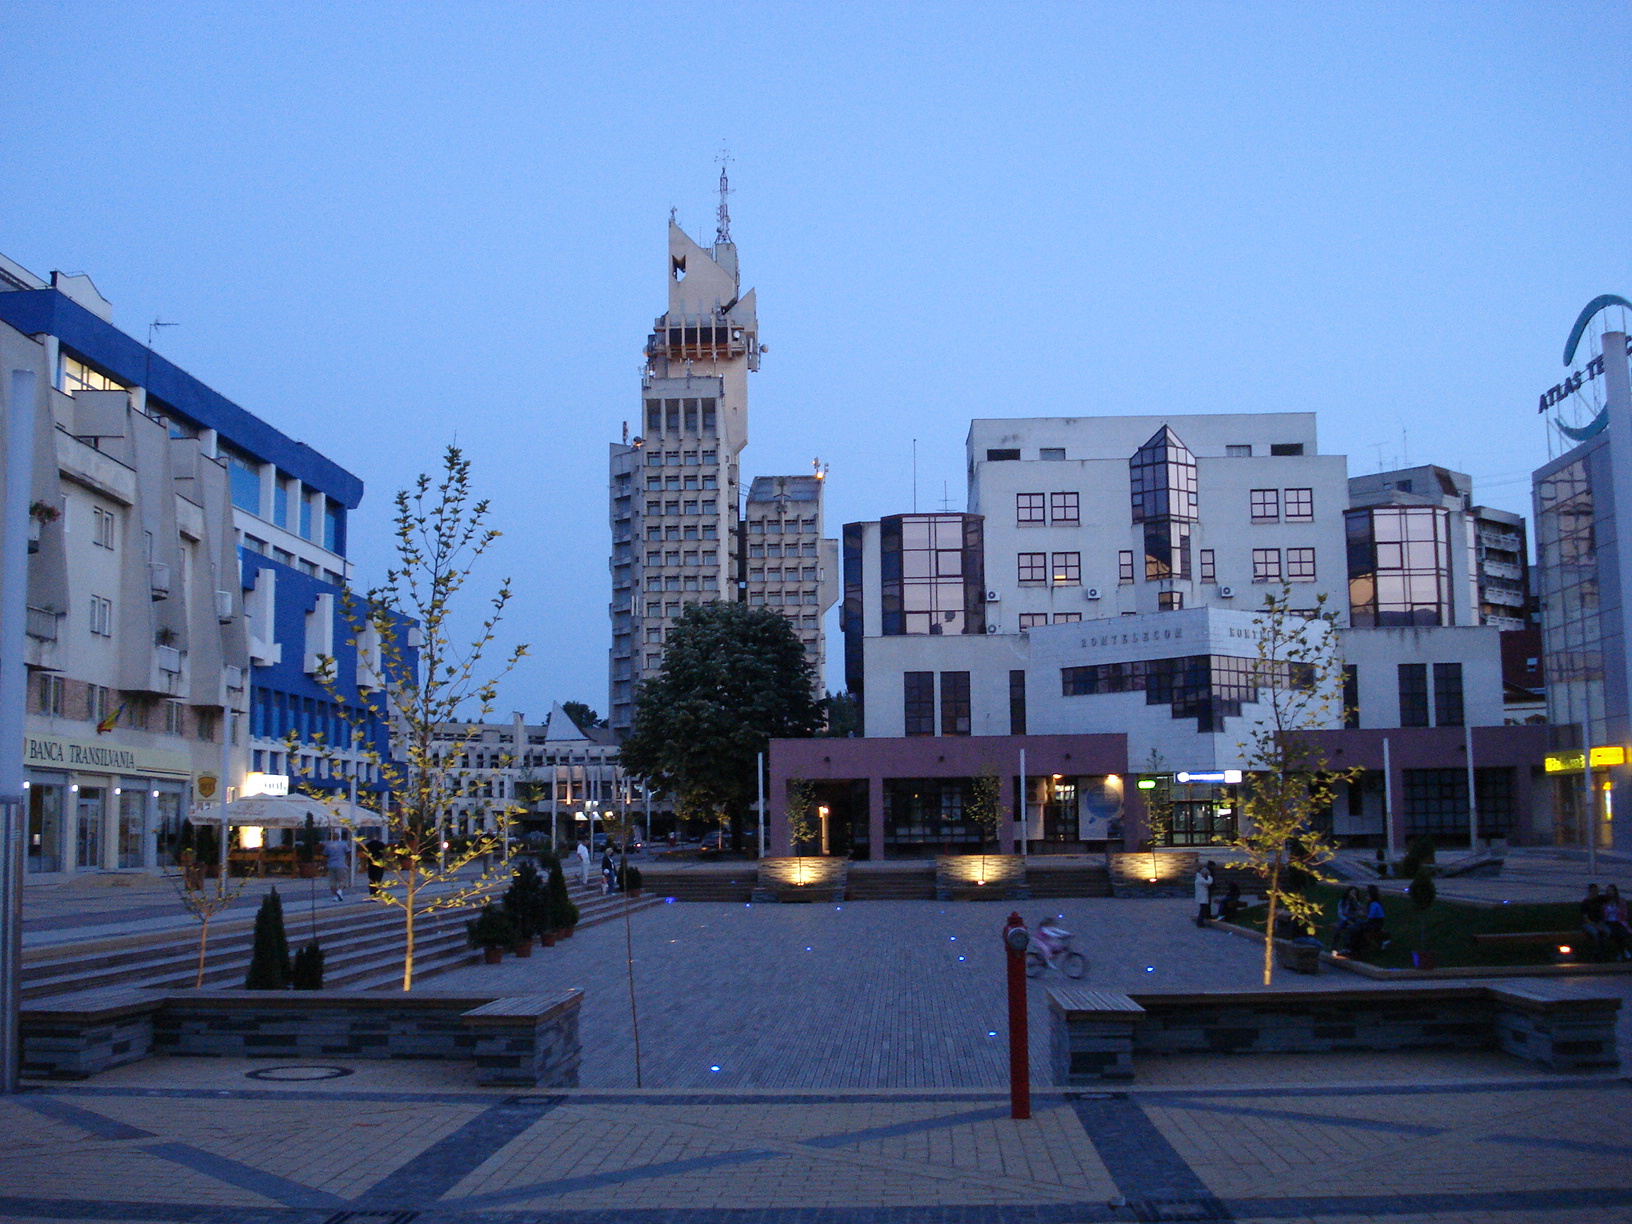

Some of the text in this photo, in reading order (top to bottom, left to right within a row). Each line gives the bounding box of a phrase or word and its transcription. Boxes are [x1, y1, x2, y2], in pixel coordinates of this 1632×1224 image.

[1538, 353, 1605, 414] ATLAS TE
[30, 739, 135, 769] BANCA TRANSILVANIA
